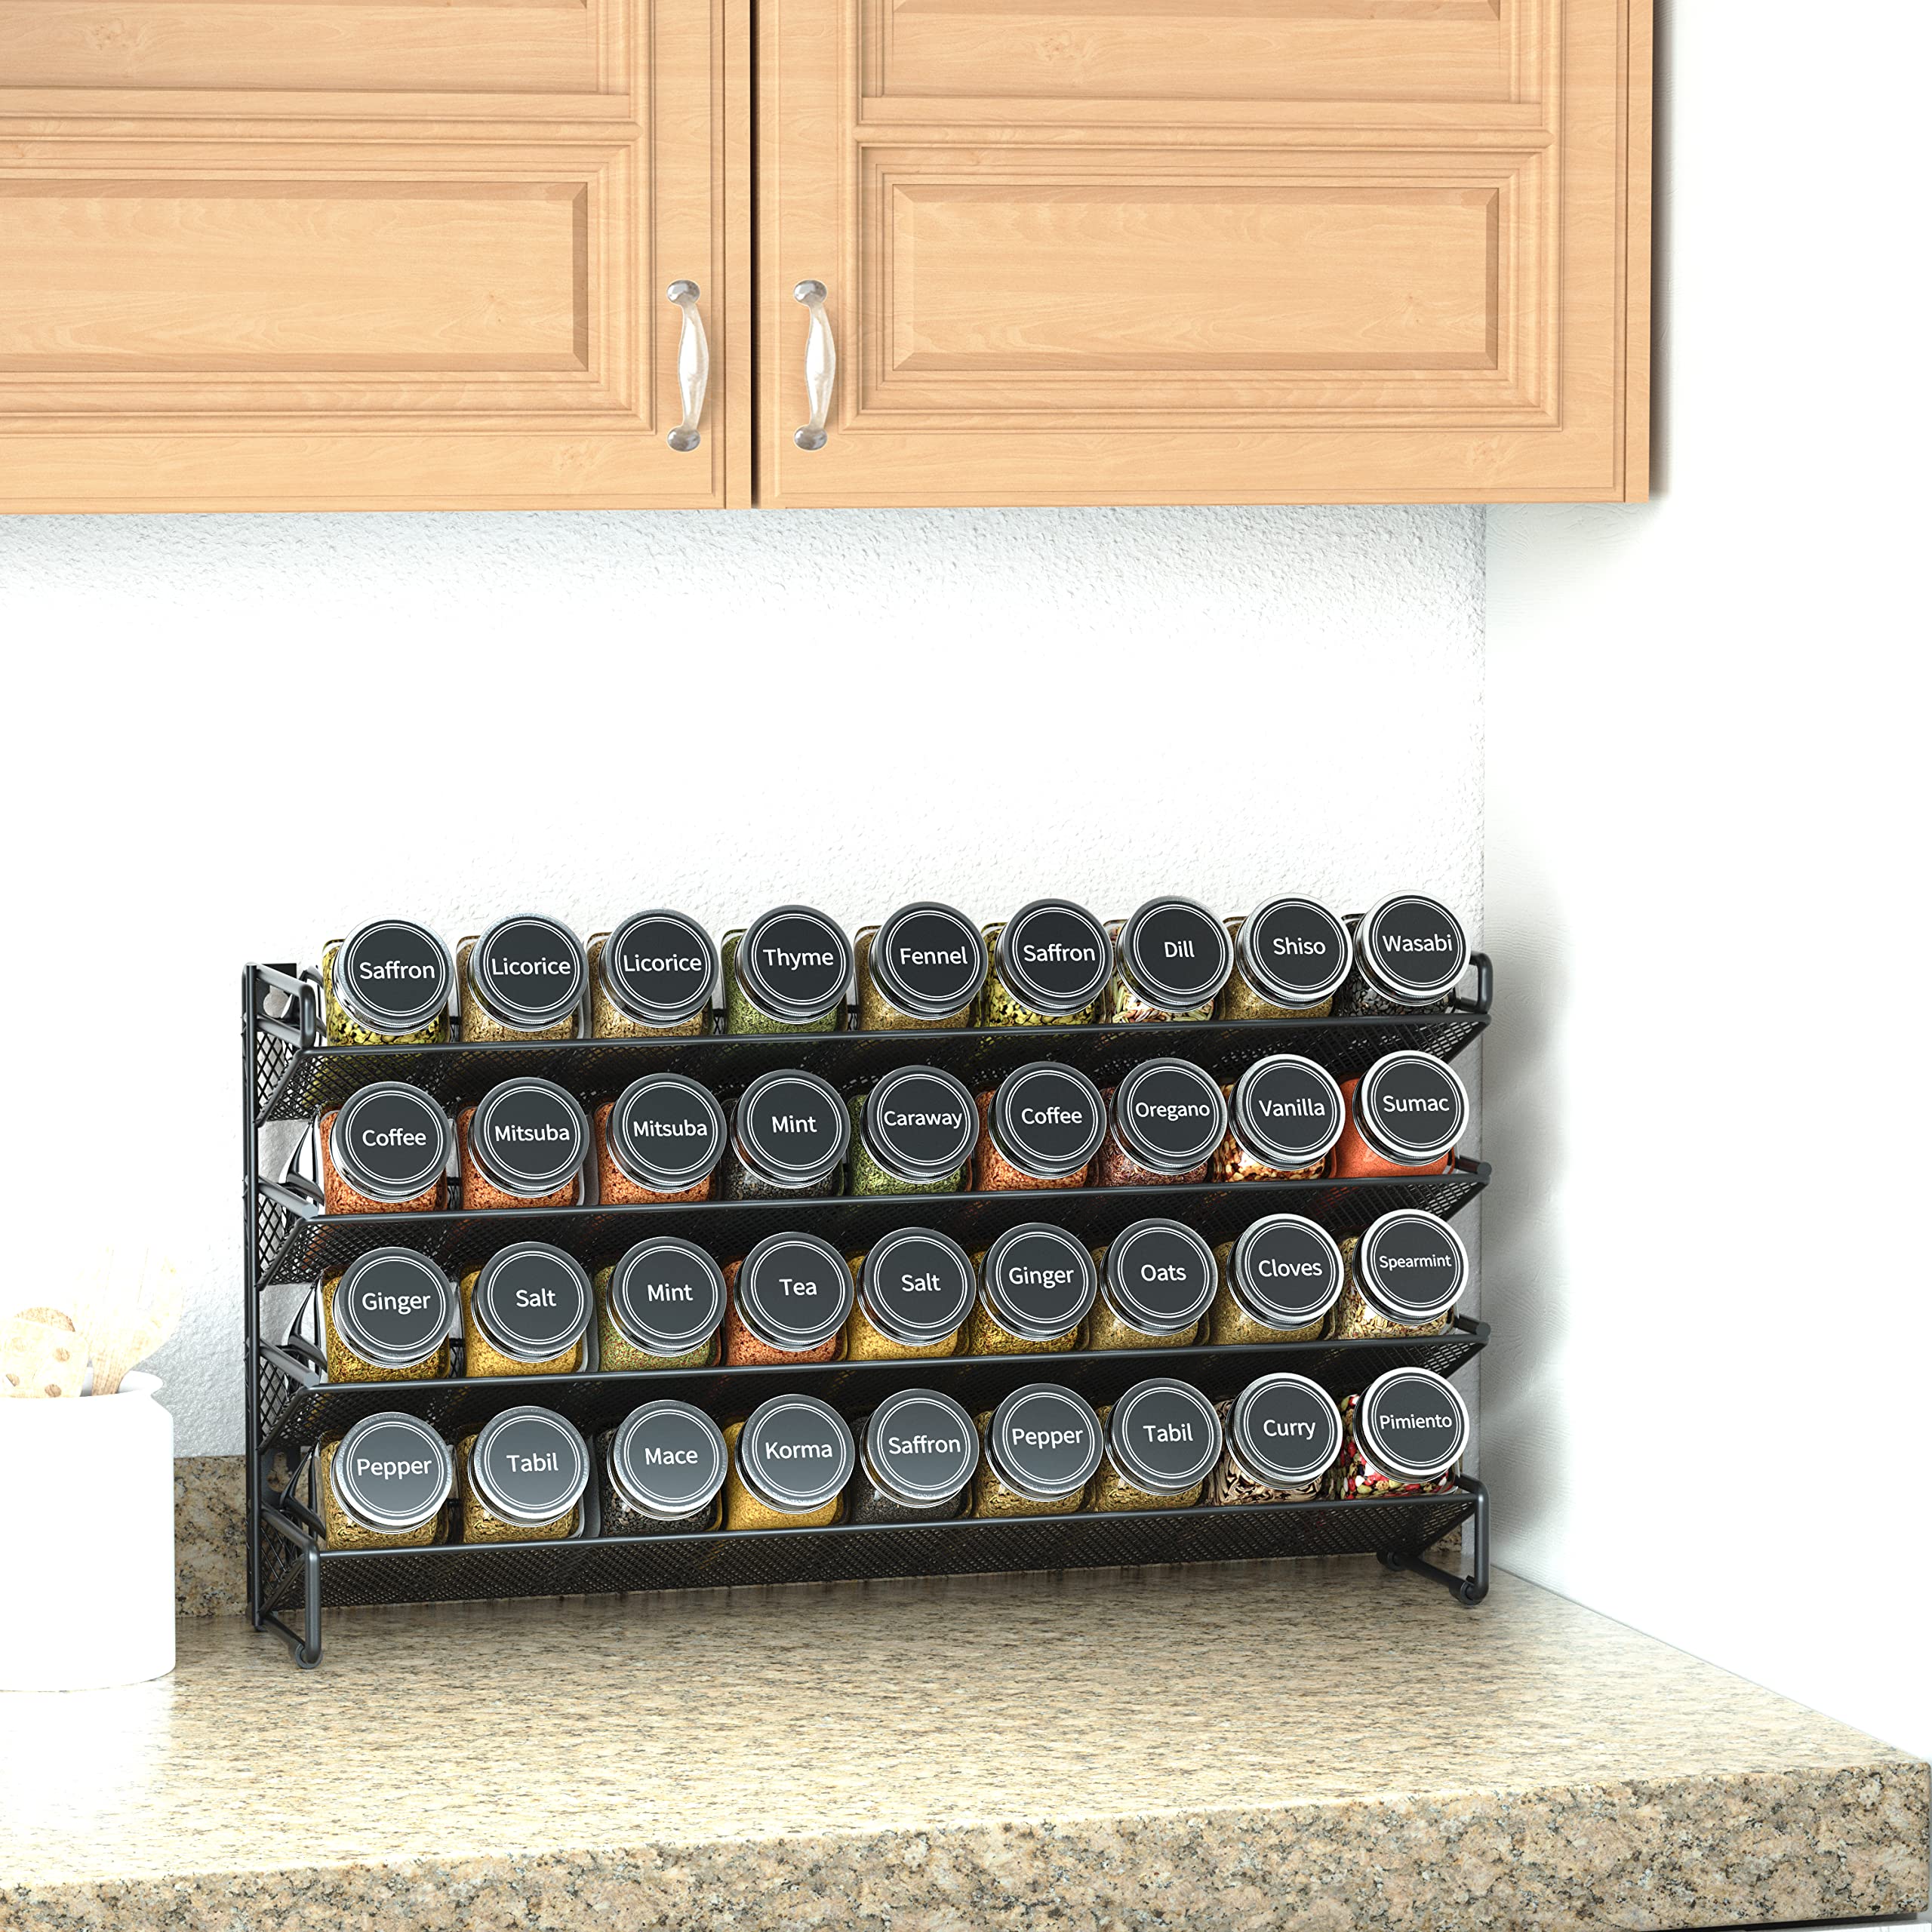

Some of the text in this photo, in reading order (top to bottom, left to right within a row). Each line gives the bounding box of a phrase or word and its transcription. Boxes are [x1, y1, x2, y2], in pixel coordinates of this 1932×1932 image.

[1023, 943, 1095, 961] Saffron
[1164, 940, 1195, 957] Dill
[1273, 937, 1325, 955] Shiso
[1383, 934, 1452, 952] Wasabi
[623, 954, 701, 971] Licorice
[763, 948, 833, 970] Thyme
[900, 946, 968, 964] Fennel
[360, 961, 435, 979] Saffron
[492, 958, 571, 975] Licorice
[1136, 1103, 1210, 1121] Oregano
[1259, 1098, 1325, 1116] Vanilla
[1383, 1096, 1449, 1112] Sumac
[772, 1115, 817, 1133] Mint
[884, 1111, 962, 1129] Caraway
[1022, 1106, 1082, 1124] Coffee
[362, 1128, 426, 1146] Coffee
[495, 1124, 570, 1141] Mitsuba
[634, 1119, 707, 1137] Mitsuba
[1259, 1259, 1322, 1277] Cloves
[1380, 1254, 1452, 1271] Spearmint
[902, 1273, 941, 1291] Salt
[1009, 1266, 1074, 1288] Ginger
[1141, 1265, 1186, 1281] Oats
[648, 1284, 693, 1301] Mint
[779, 1279, 817, 1295] Tea
[362, 1292, 430, 1315] Ginger
[516, 1288, 556, 1307] Salt
[1264, 1420, 1315, 1440] Curry
[1380, 1414, 1452, 1429] Pimiento
[1012, 1429, 1083, 1449] Pepper
[1143, 1423, 1193, 1442] Tabil
[766, 1442, 832, 1459] Korma
[889, 1435, 961, 1454] Saffron
[506, 1453, 558, 1472] Tabil
[645, 1448, 697, 1465] Mace
[357, 1459, 432, 1479] Pepper
